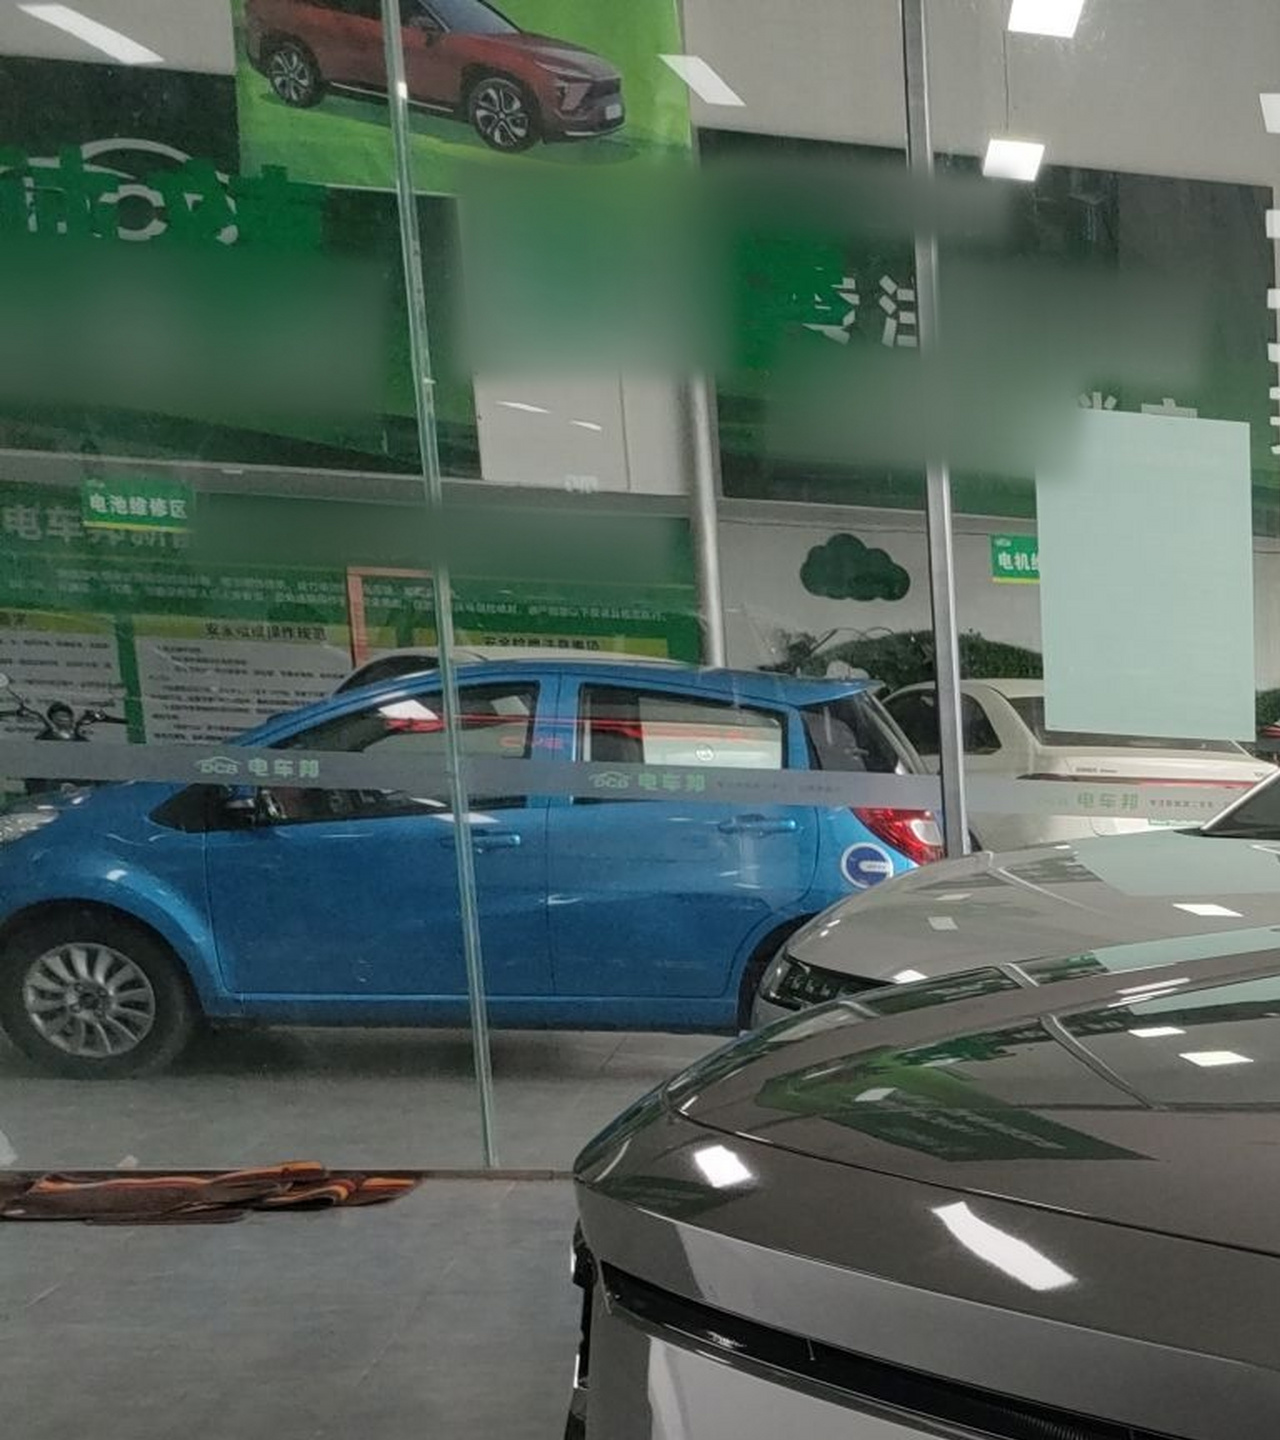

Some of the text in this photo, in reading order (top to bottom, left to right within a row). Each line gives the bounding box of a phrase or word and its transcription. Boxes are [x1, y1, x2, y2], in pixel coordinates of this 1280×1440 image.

[88, 493, 188, 519] 电池维修区
